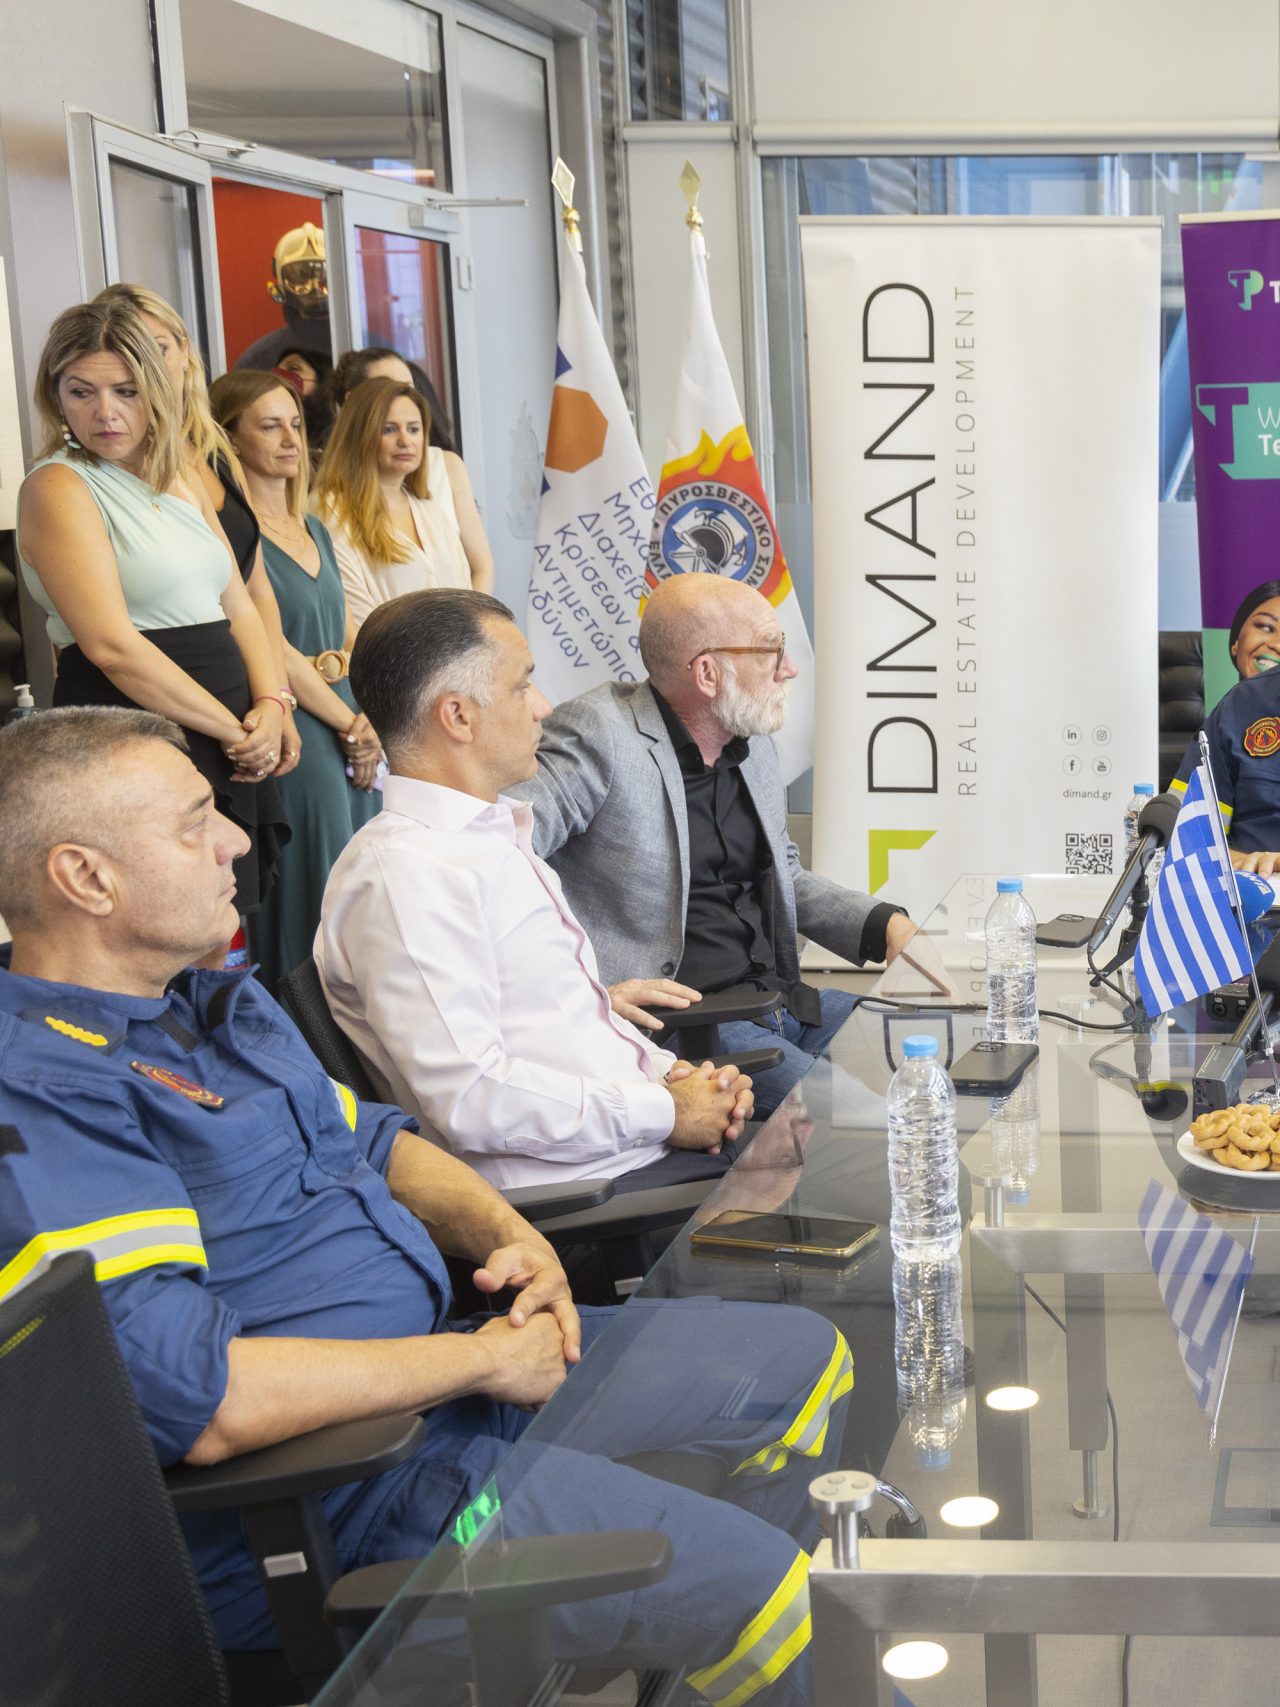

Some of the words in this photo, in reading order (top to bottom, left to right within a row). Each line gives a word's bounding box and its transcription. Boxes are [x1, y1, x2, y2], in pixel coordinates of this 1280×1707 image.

[954, 286, 976, 548] DEVELOPMENT
[659, 484, 771, 548] ΠΥΡΟΣΒΕΣΤΙΚΟ
[863, 282, 938, 794] DIMAND
[956, 570, 976, 694] ESTATE
[957, 715, 977, 797] REAL
[1062, 789, 1112, 800] dimand.gr
